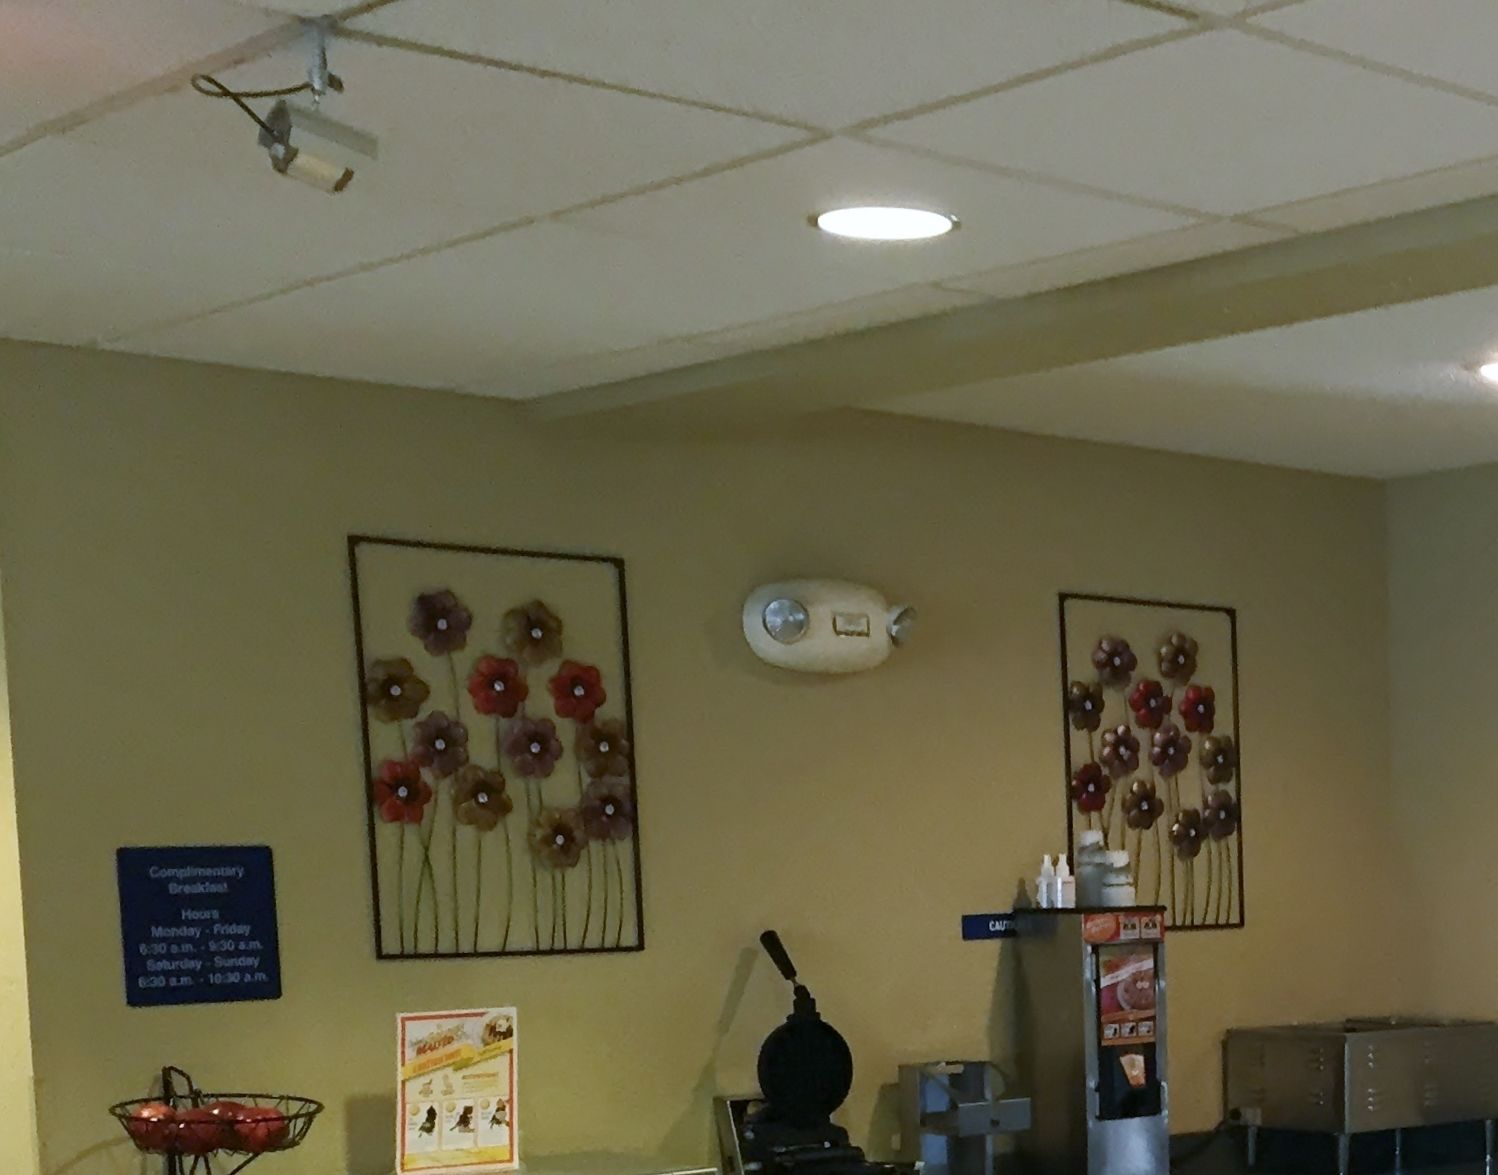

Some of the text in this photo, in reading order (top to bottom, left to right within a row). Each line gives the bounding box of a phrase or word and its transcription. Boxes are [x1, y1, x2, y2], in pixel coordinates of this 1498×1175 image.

[149, 865, 245, 880] Complimentary
[168, 882, 228, 894] Breakfast
[181, 908, 220, 920] Hours
[151, 926, 201, 938] Monday
[213, 924, 251, 936] Friday
[170, 944, 197, 954] a.m.
[238, 940, 264, 951] a.m.
[146, 958, 202, 971] Saturday
[214, 956, 261, 969] Sunday
